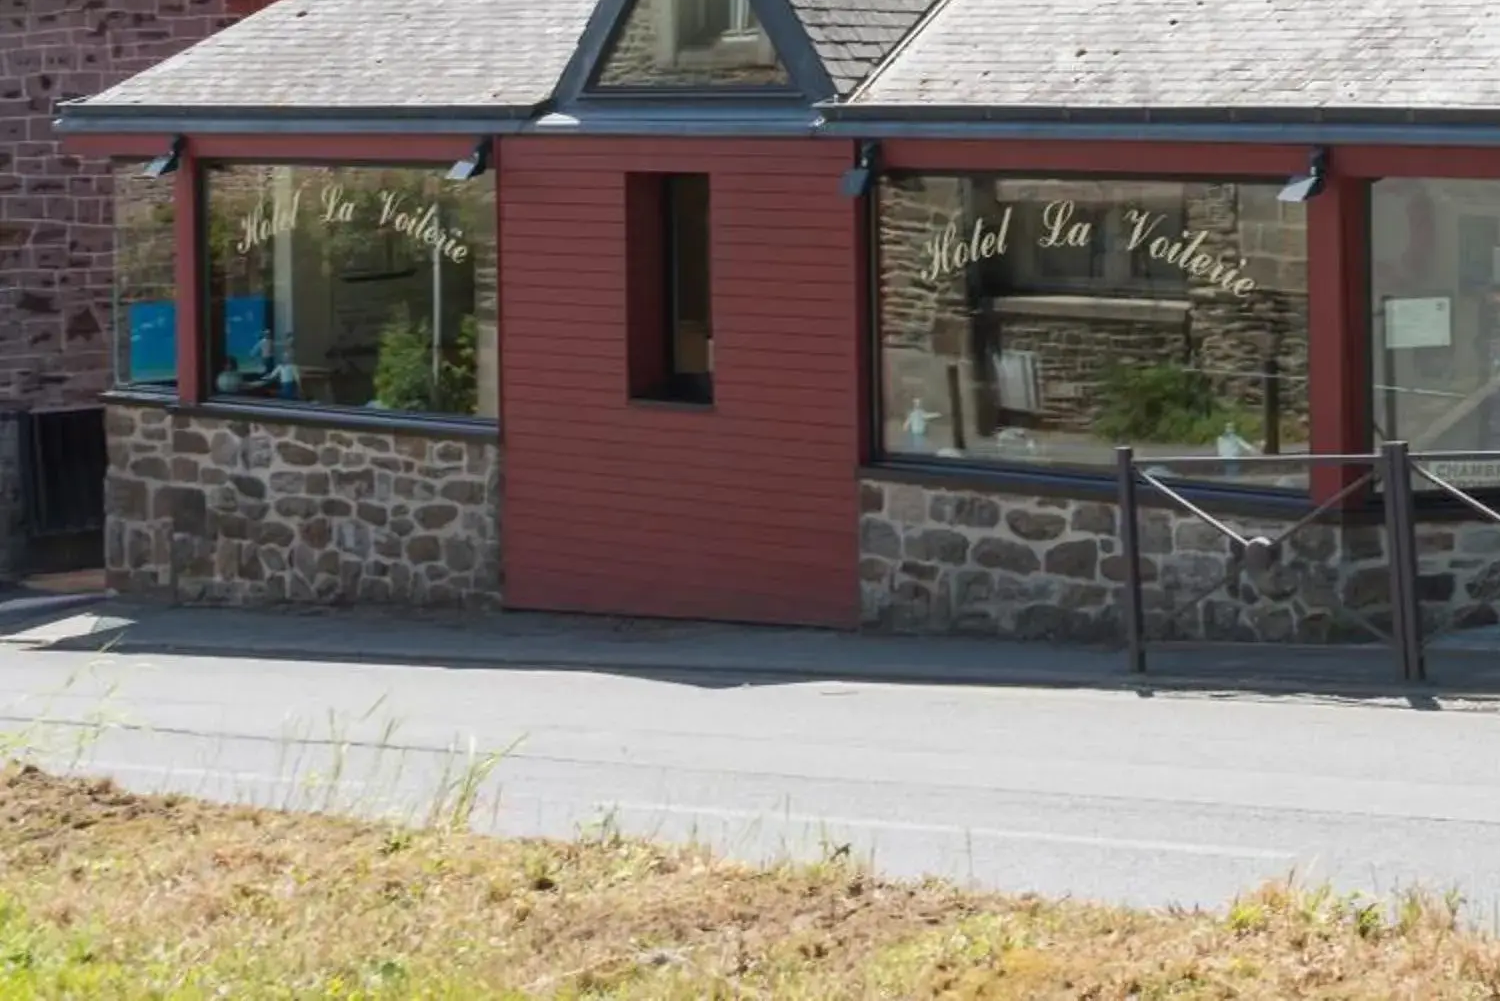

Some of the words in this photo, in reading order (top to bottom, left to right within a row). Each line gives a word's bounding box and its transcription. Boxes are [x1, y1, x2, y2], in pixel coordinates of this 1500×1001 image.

[237, 189, 300, 254] Hotel
[320, 185, 355, 223] La
[379, 190, 468, 264] Voilerie
[921, 207, 1012, 281] Hotel
[1038, 199, 1093, 248] La
[1124, 209, 1257, 298] Voilerie
